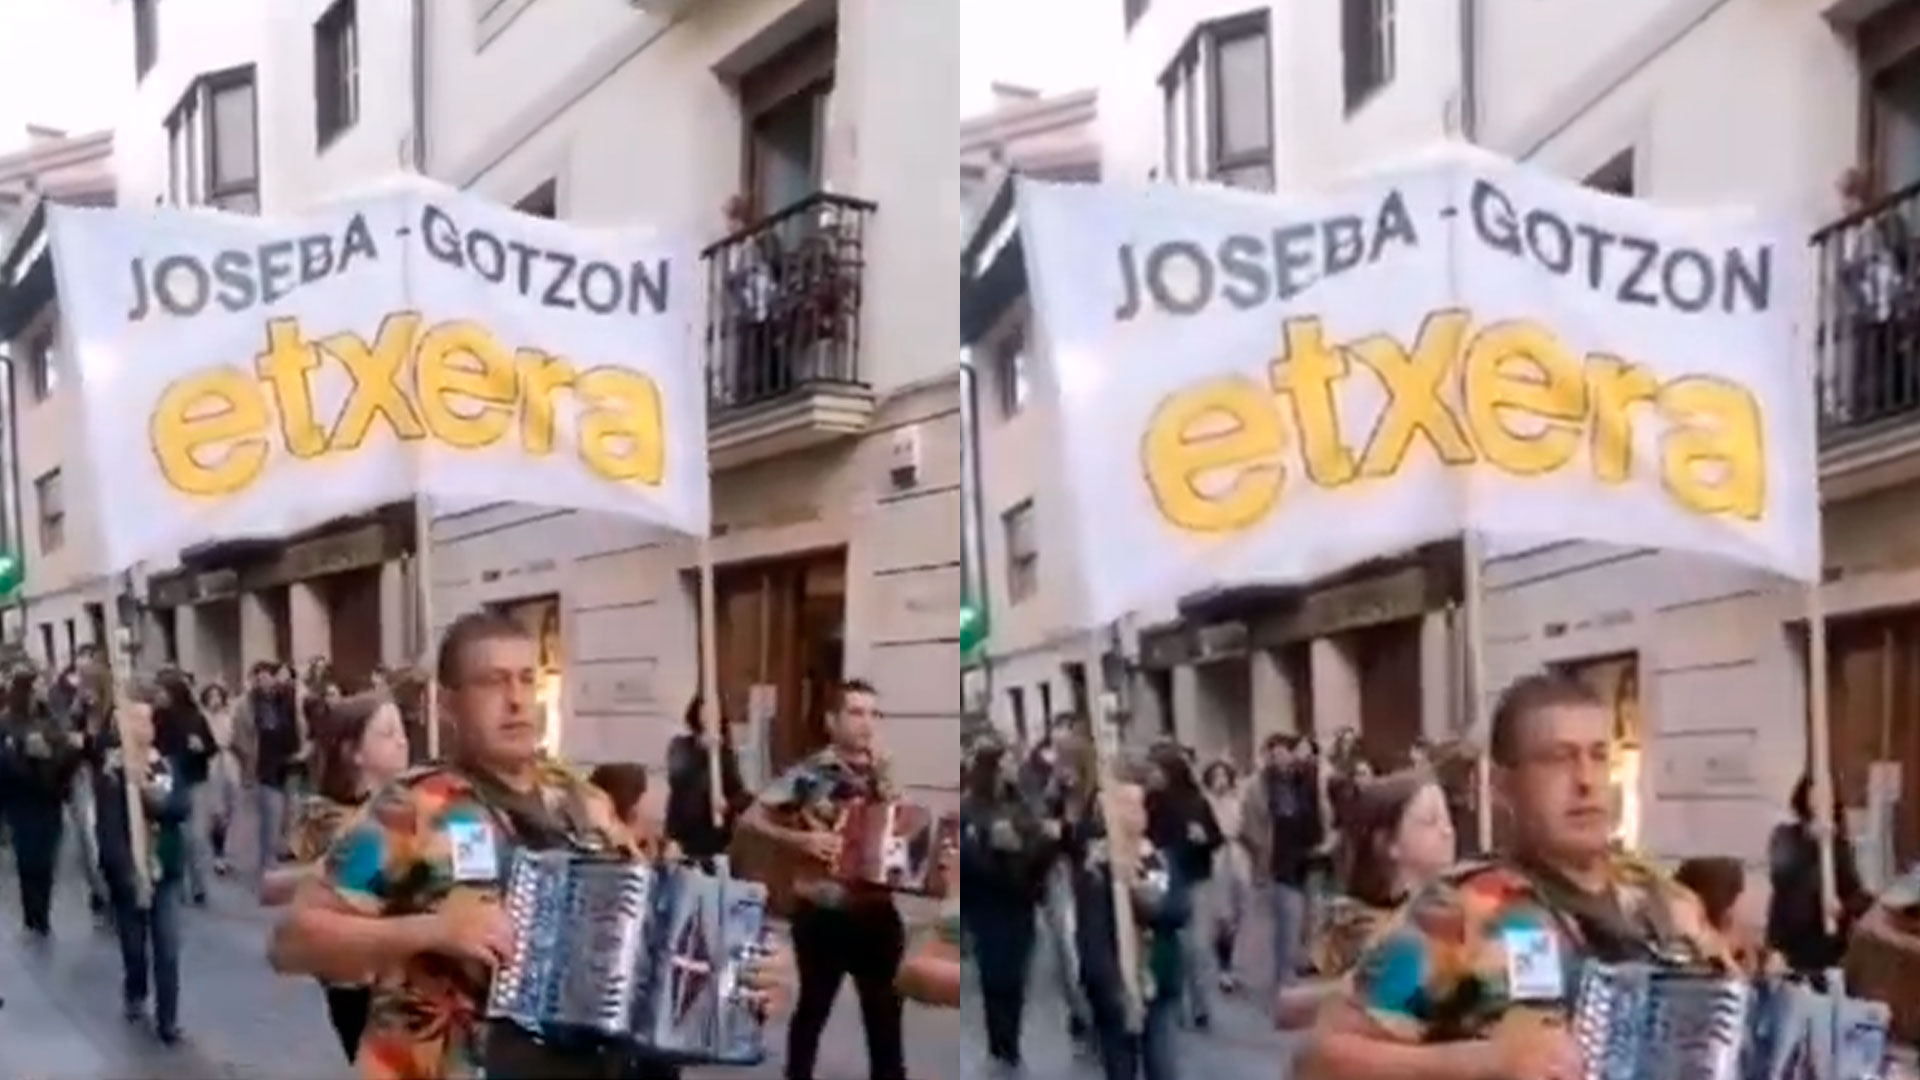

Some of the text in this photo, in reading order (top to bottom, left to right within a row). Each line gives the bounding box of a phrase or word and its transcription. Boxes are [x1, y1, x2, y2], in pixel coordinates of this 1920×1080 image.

[127, 212, 377, 321] JOSEBA
[421, 204, 670, 315] GOTZON
[1115, 190, 1417, 322] JOSEBA
[1469, 179, 1772, 313] GOTZON
[150, 310, 666, 496] etxera
[1140, 308, 1767, 534] etxera
